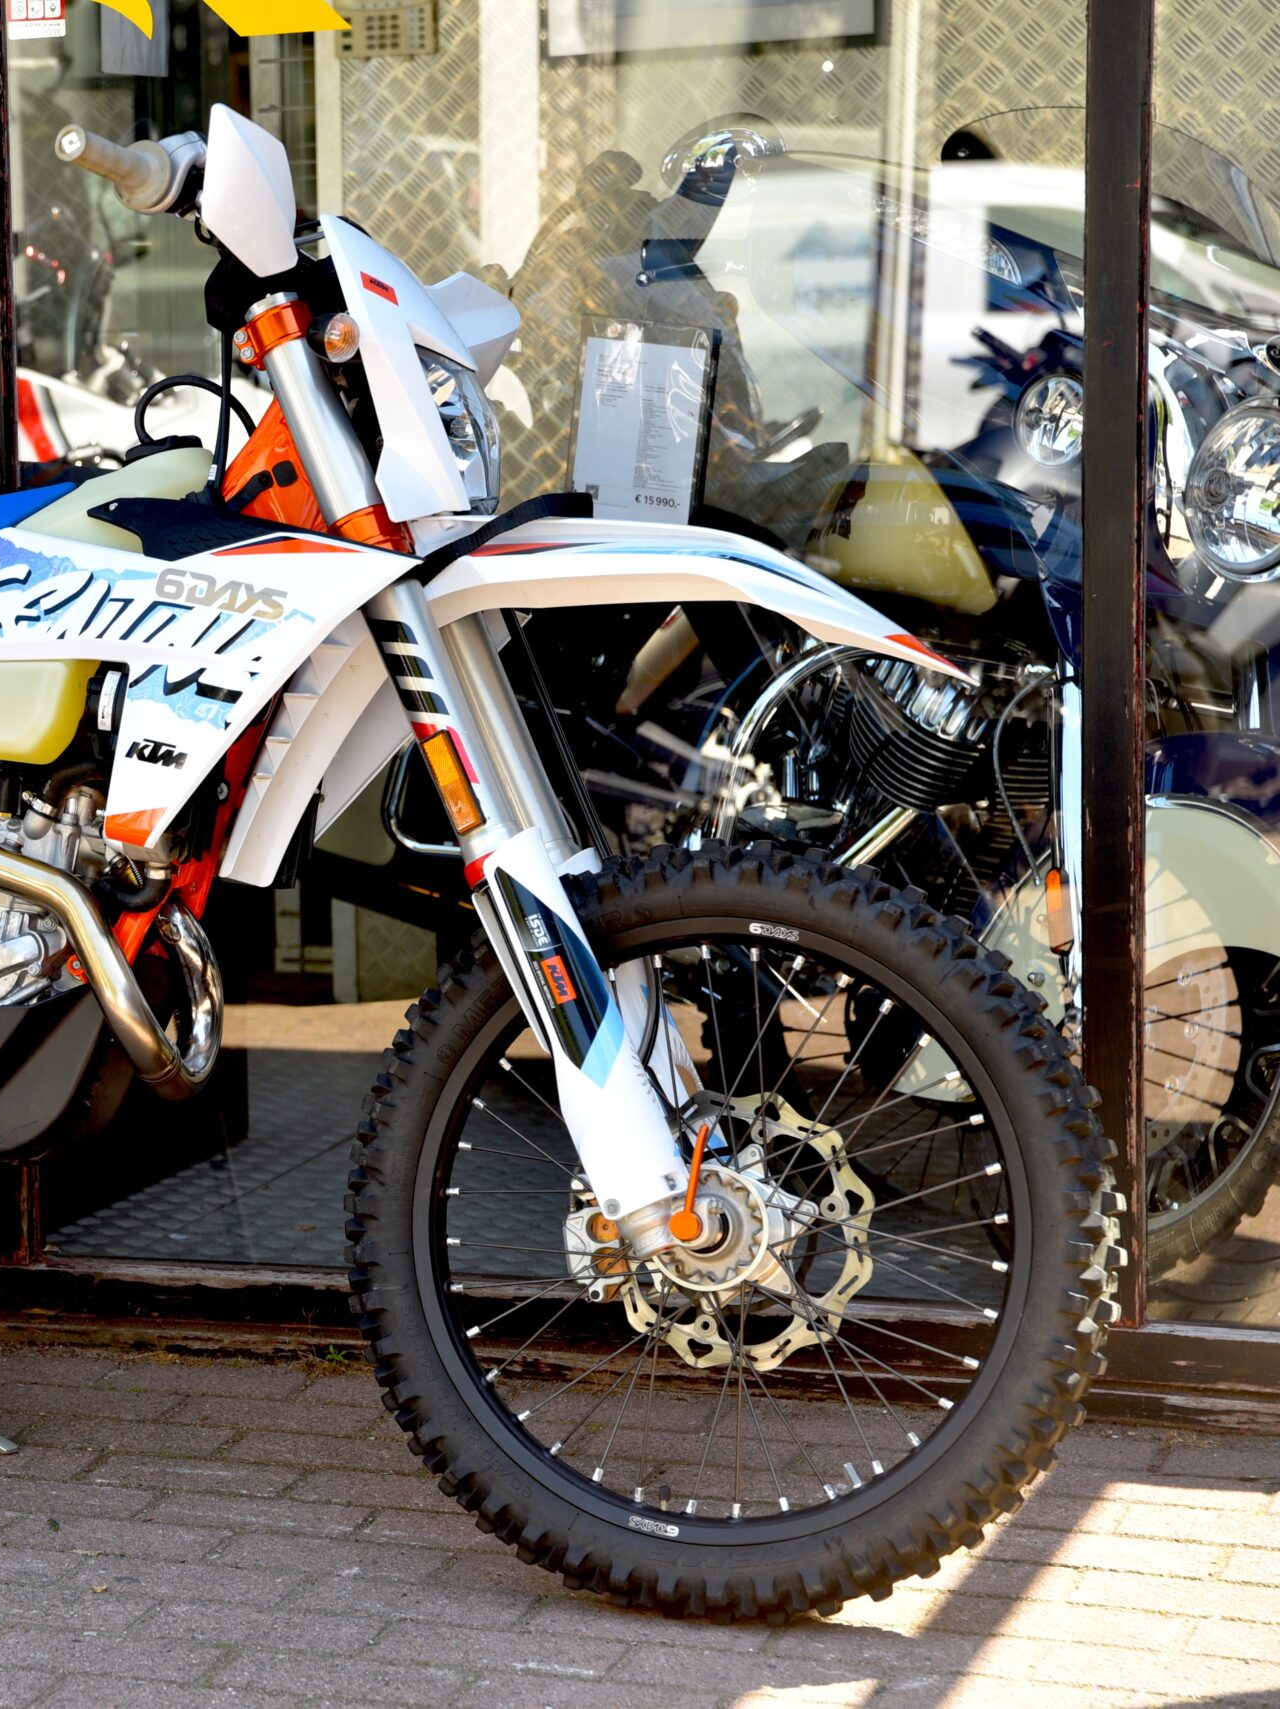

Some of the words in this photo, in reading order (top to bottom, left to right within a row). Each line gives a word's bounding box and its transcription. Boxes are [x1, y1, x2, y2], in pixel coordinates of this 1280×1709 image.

[124, 738, 189, 770] KTM
[528, 913, 549, 946] ISDE
[547, 963, 569, 997] KTM
